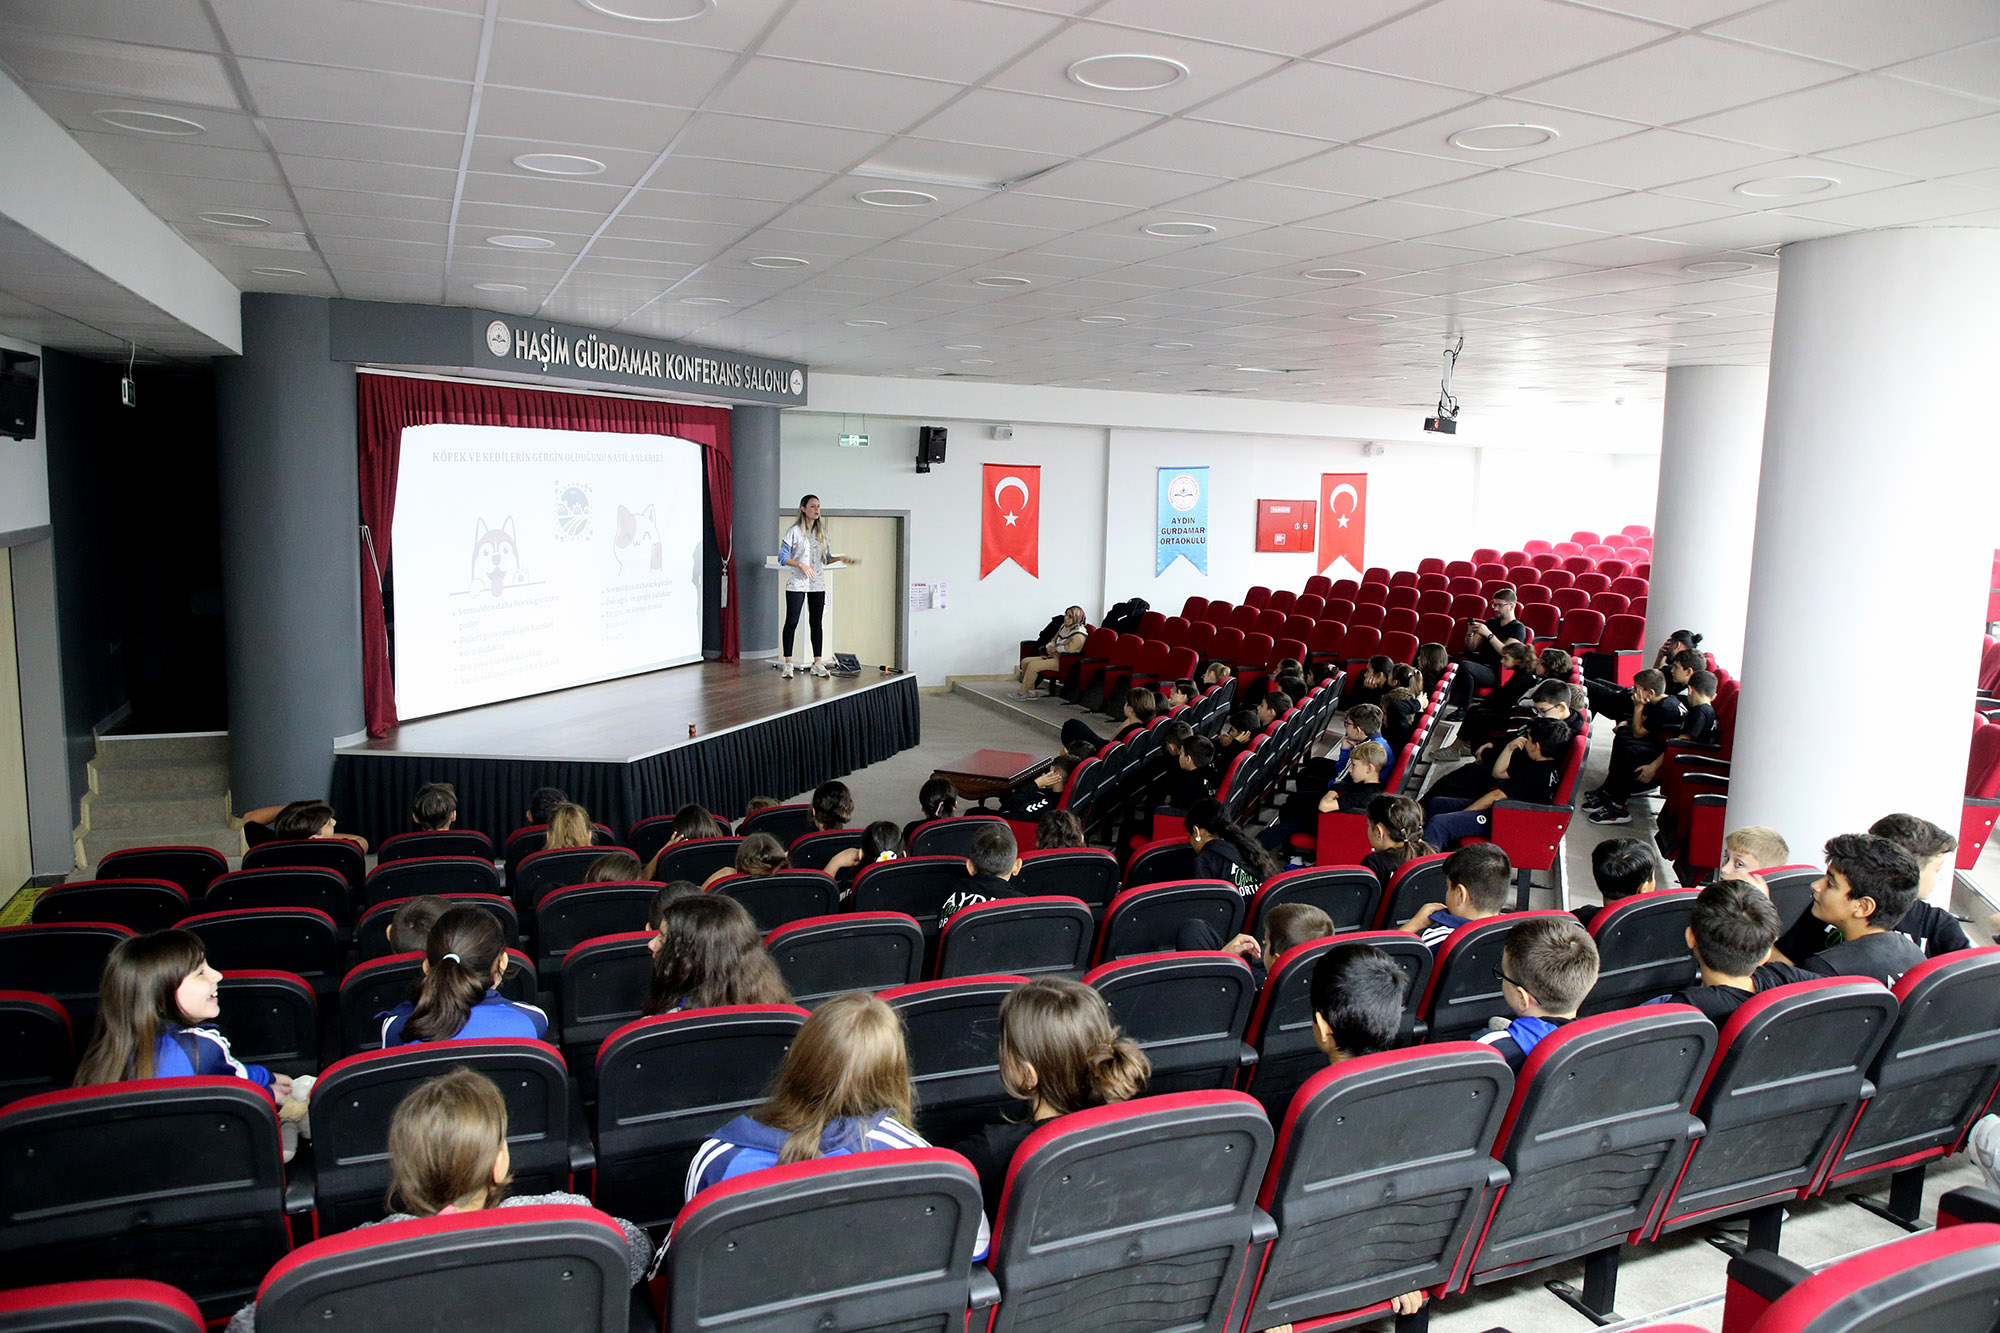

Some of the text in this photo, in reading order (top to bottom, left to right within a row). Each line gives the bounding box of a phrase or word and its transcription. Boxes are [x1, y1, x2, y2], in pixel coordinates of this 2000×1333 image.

[514, 327, 570, 371] HAŞİM
[574, 333, 662, 378] GÜRDAMAR
[665, 353, 742, 388] KONFERANS
[742, 365, 790, 394] SALONU
[432, 450, 466, 462] KÖPEK
[469, 451, 480, 462] VE
[483, 450, 531, 462] KEDİLERİN
[1171, 517, 1195, 525] AYDIN
[1160, 536, 1206, 545] ORTAOKULU
